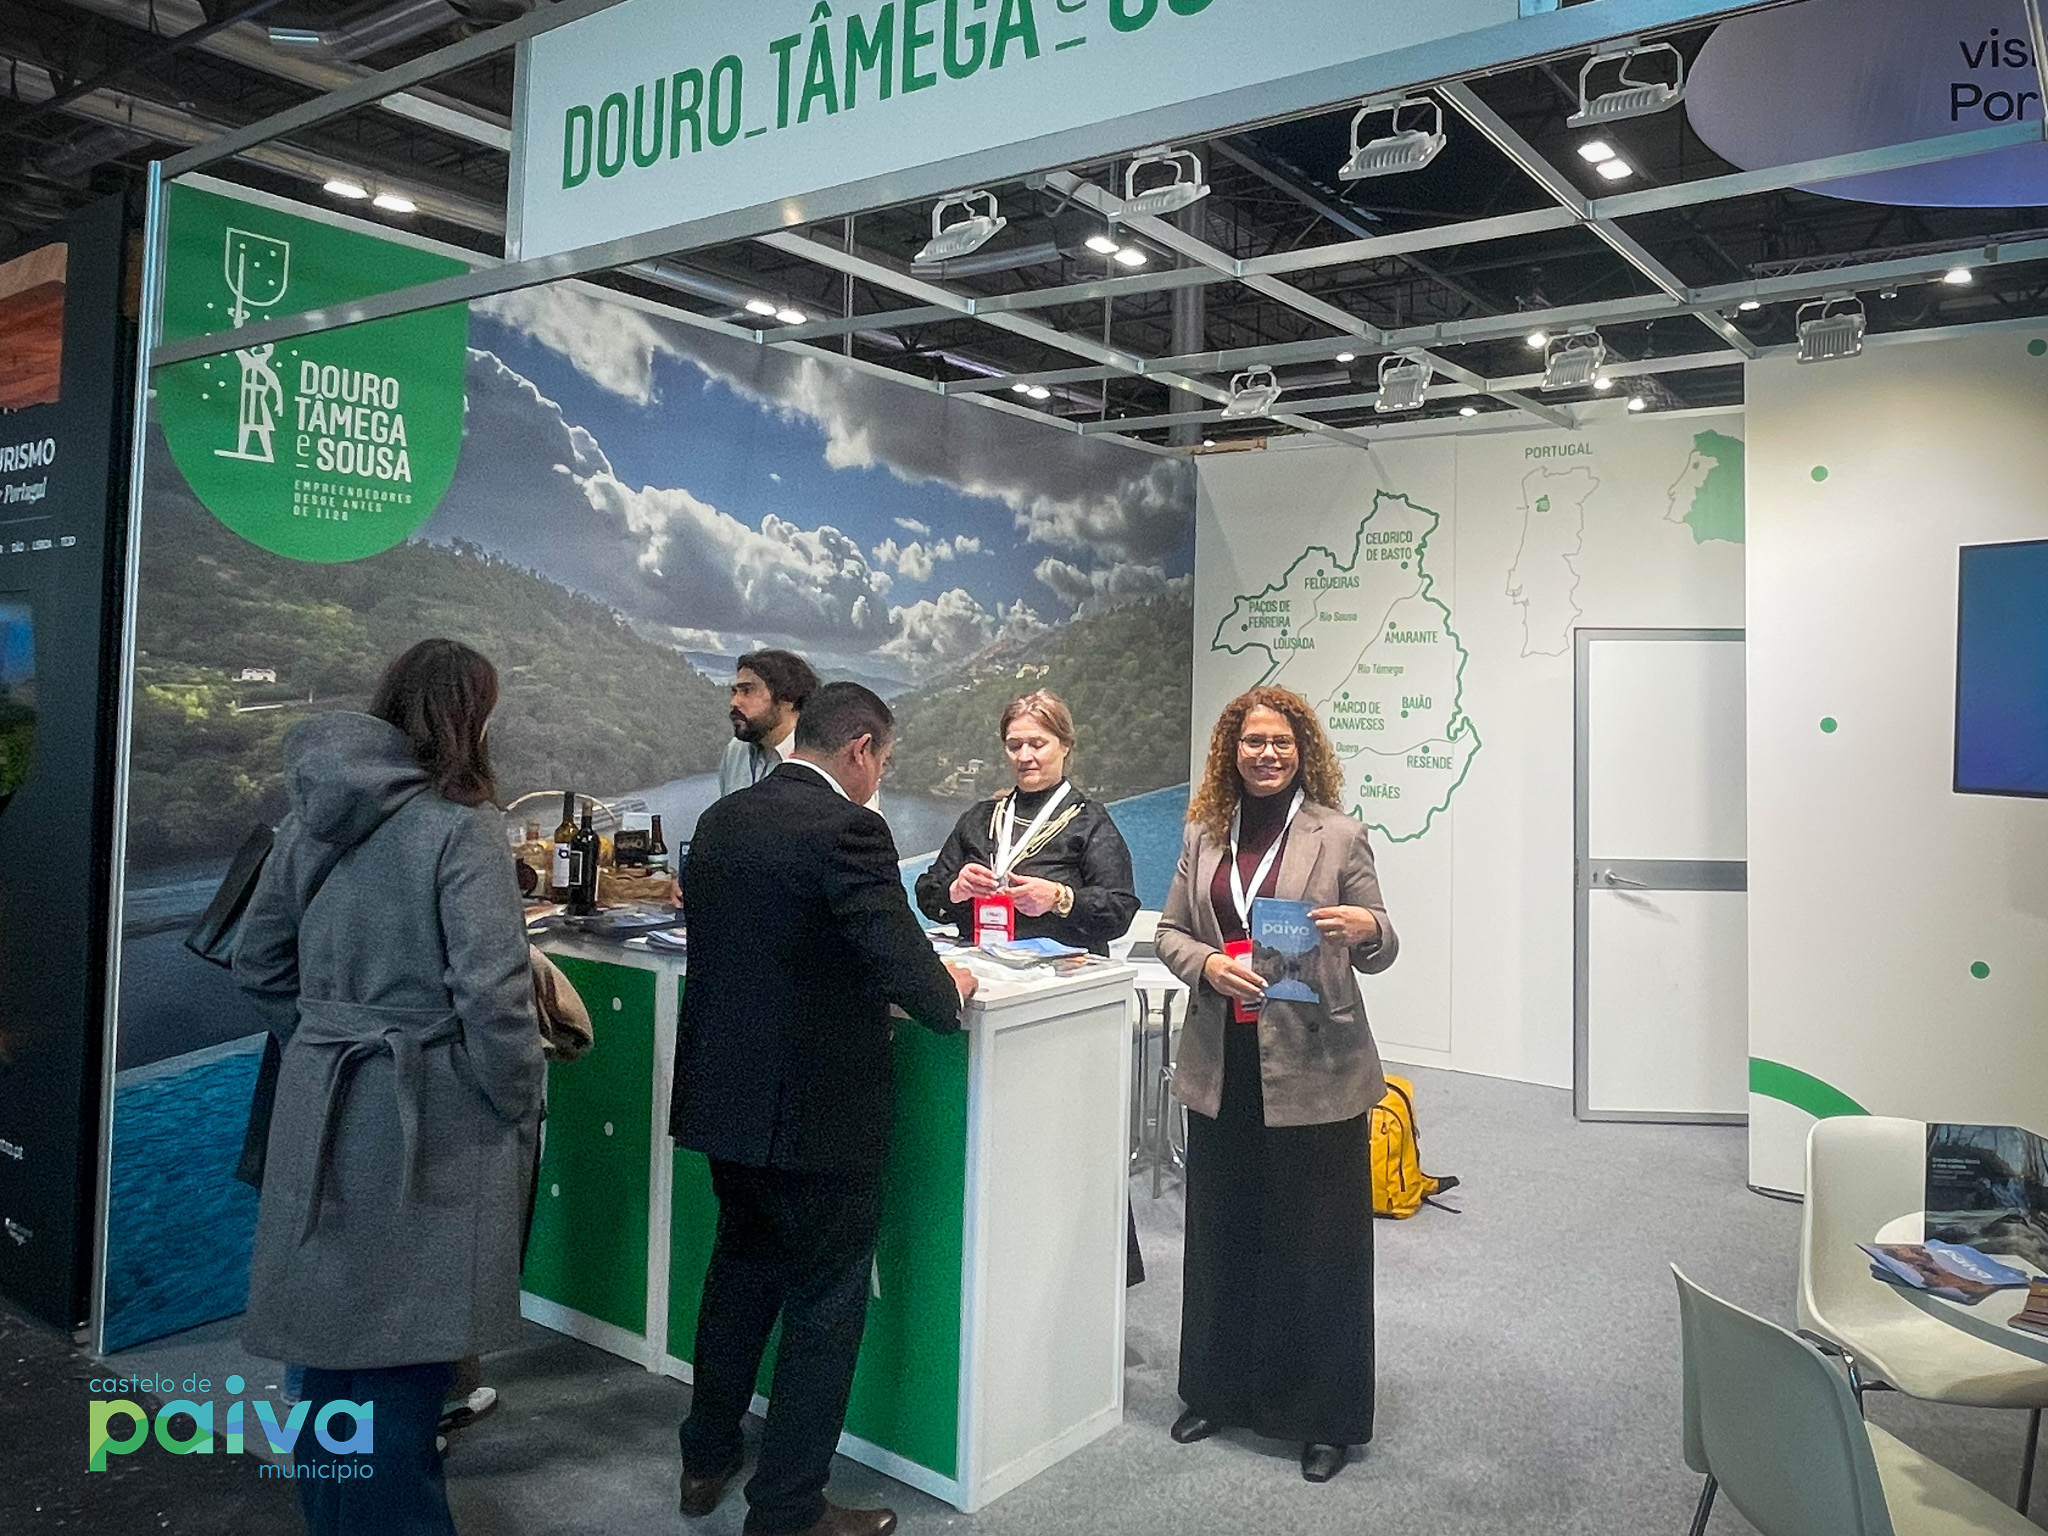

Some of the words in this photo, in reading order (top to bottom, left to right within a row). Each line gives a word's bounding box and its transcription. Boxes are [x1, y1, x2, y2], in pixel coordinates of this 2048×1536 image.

[300, 360, 400, 410] DOURO
[294, 393, 408, 447] TÂMEGA
[1525, 442, 1594, 459] PORTUGAL
[316, 437, 412, 483] SOUSA
[294, 480, 412, 504] EMPREENDEDORES
[294, 492, 335, 508] DESDE
[342, 499, 382, 513] ANTES
[293, 505, 309, 517] DE
[1365, 530, 1413, 545] CELORICO
[1366, 549, 1380, 561] DE
[1381, 547, 1412, 560] BASTO
[1304, 576, 1360, 589] FELGUEIRAS
[1249, 600, 1278, 616] PAÇOS
[1279, 600, 1291, 613] DE
[1249, 616, 1291, 629] FERREIRA
[1273, 638, 1315, 650] LOUSADA
[1384, 631, 1439, 644] AMARANTE
[1357, 664, 1371, 674] Rio
[1333, 701, 1367, 714] MARCO
[1369, 701, 1381, 714] DE
[1402, 694, 1432, 709] BAIÃO
[1329, 717, 1385, 731] CANAVESES
[1407, 755, 1453, 769] RESENDE
[1360, 783, 1401, 798] CINFÃES
[1262, 920, 1310, 936] paiva
